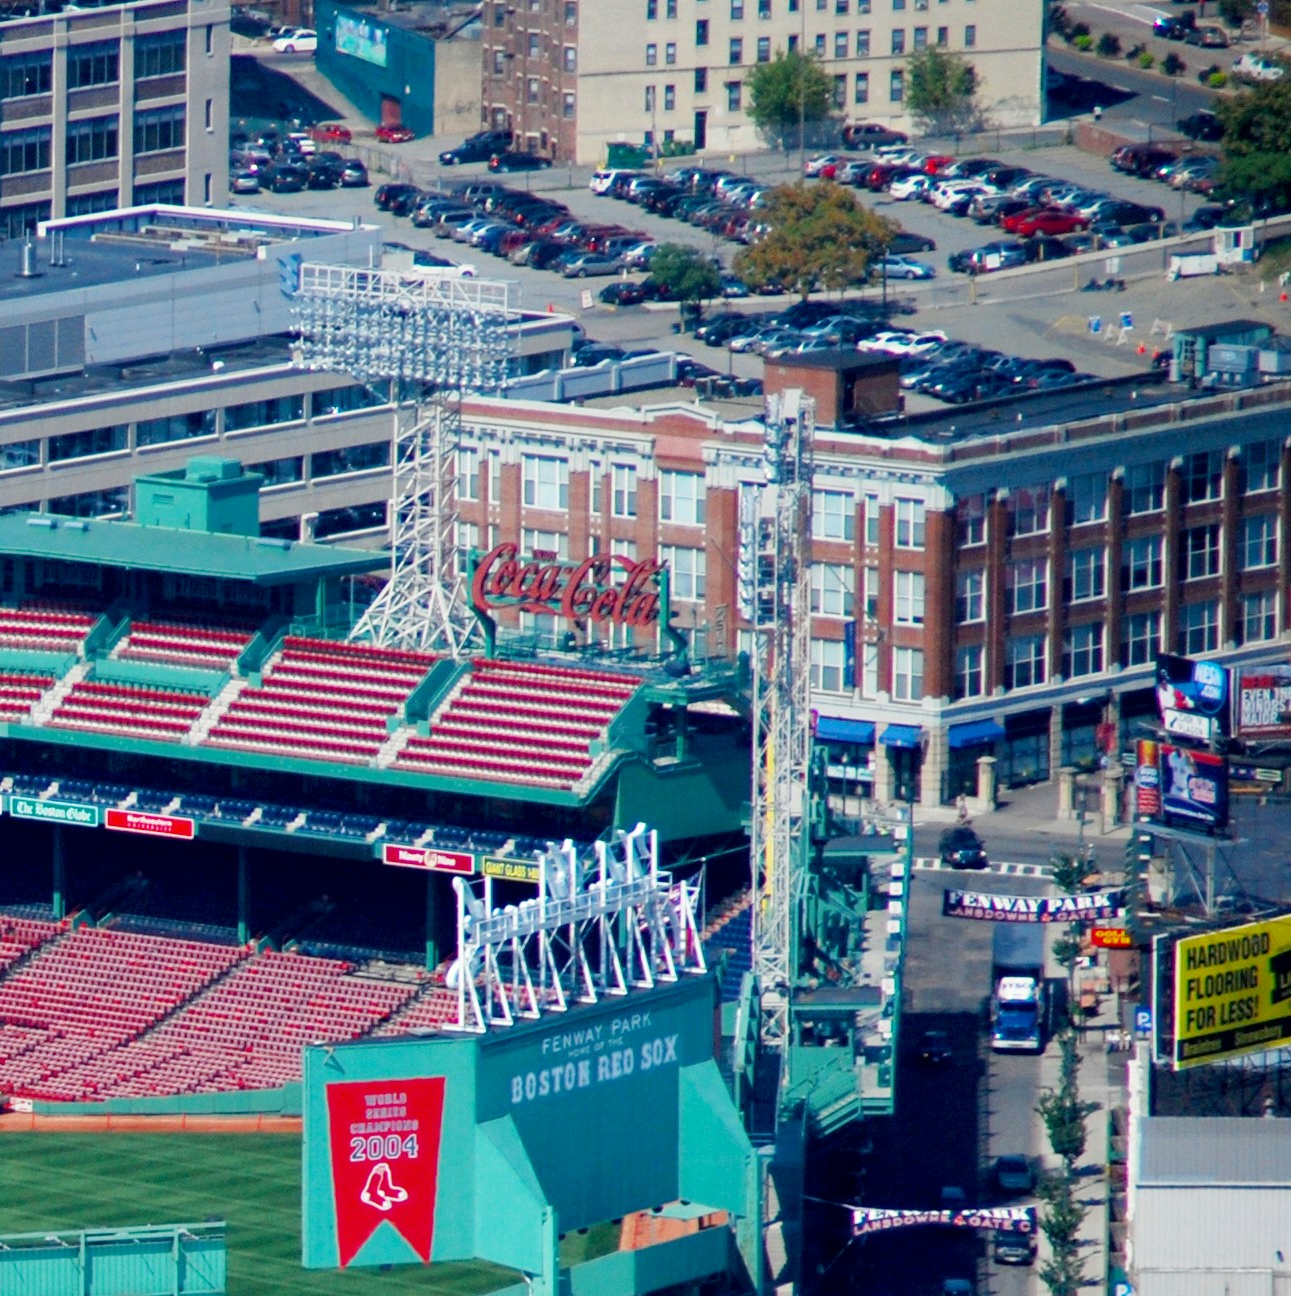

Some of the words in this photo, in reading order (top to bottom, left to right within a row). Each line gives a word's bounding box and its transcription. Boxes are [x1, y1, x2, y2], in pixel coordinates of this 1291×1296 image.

[472, 542, 665, 626] Coca-Cola
[17, 801, 33, 815] The
[35, 803, 66, 818] Boston
[66, 806, 92, 822] Globe
[485, 861, 505, 875] GIANT
[505, 863, 526, 879] GLASS
[948, 890, 1039, 913] FENWAY
[1046, 894, 1111, 913] PARK
[1186, 932, 1270, 970] HARDWOOD
[1186, 965, 1258, 1001] FLOORING
[1186, 1005, 1216, 1032] FOR
[1220, 995, 1260, 1025] LESS!
[542, 1025, 603, 1054] FENWAY
[611, 1011, 652, 1036] PARK
[511, 1059, 591, 1104] BOSTON
[597, 1047, 635, 1082] RED
[640, 1034, 679, 1071] SOX
[364, 1092, 408, 1106] WORLD
[365, 1106, 407, 1120] SERIES
[349, 1119, 420, 1135] CHAMPIONS
[349, 1133, 419, 1162] 2004
[854, 1213, 951, 1236] LANSDOWNE
[969, 1217, 1014, 1231] GATE
